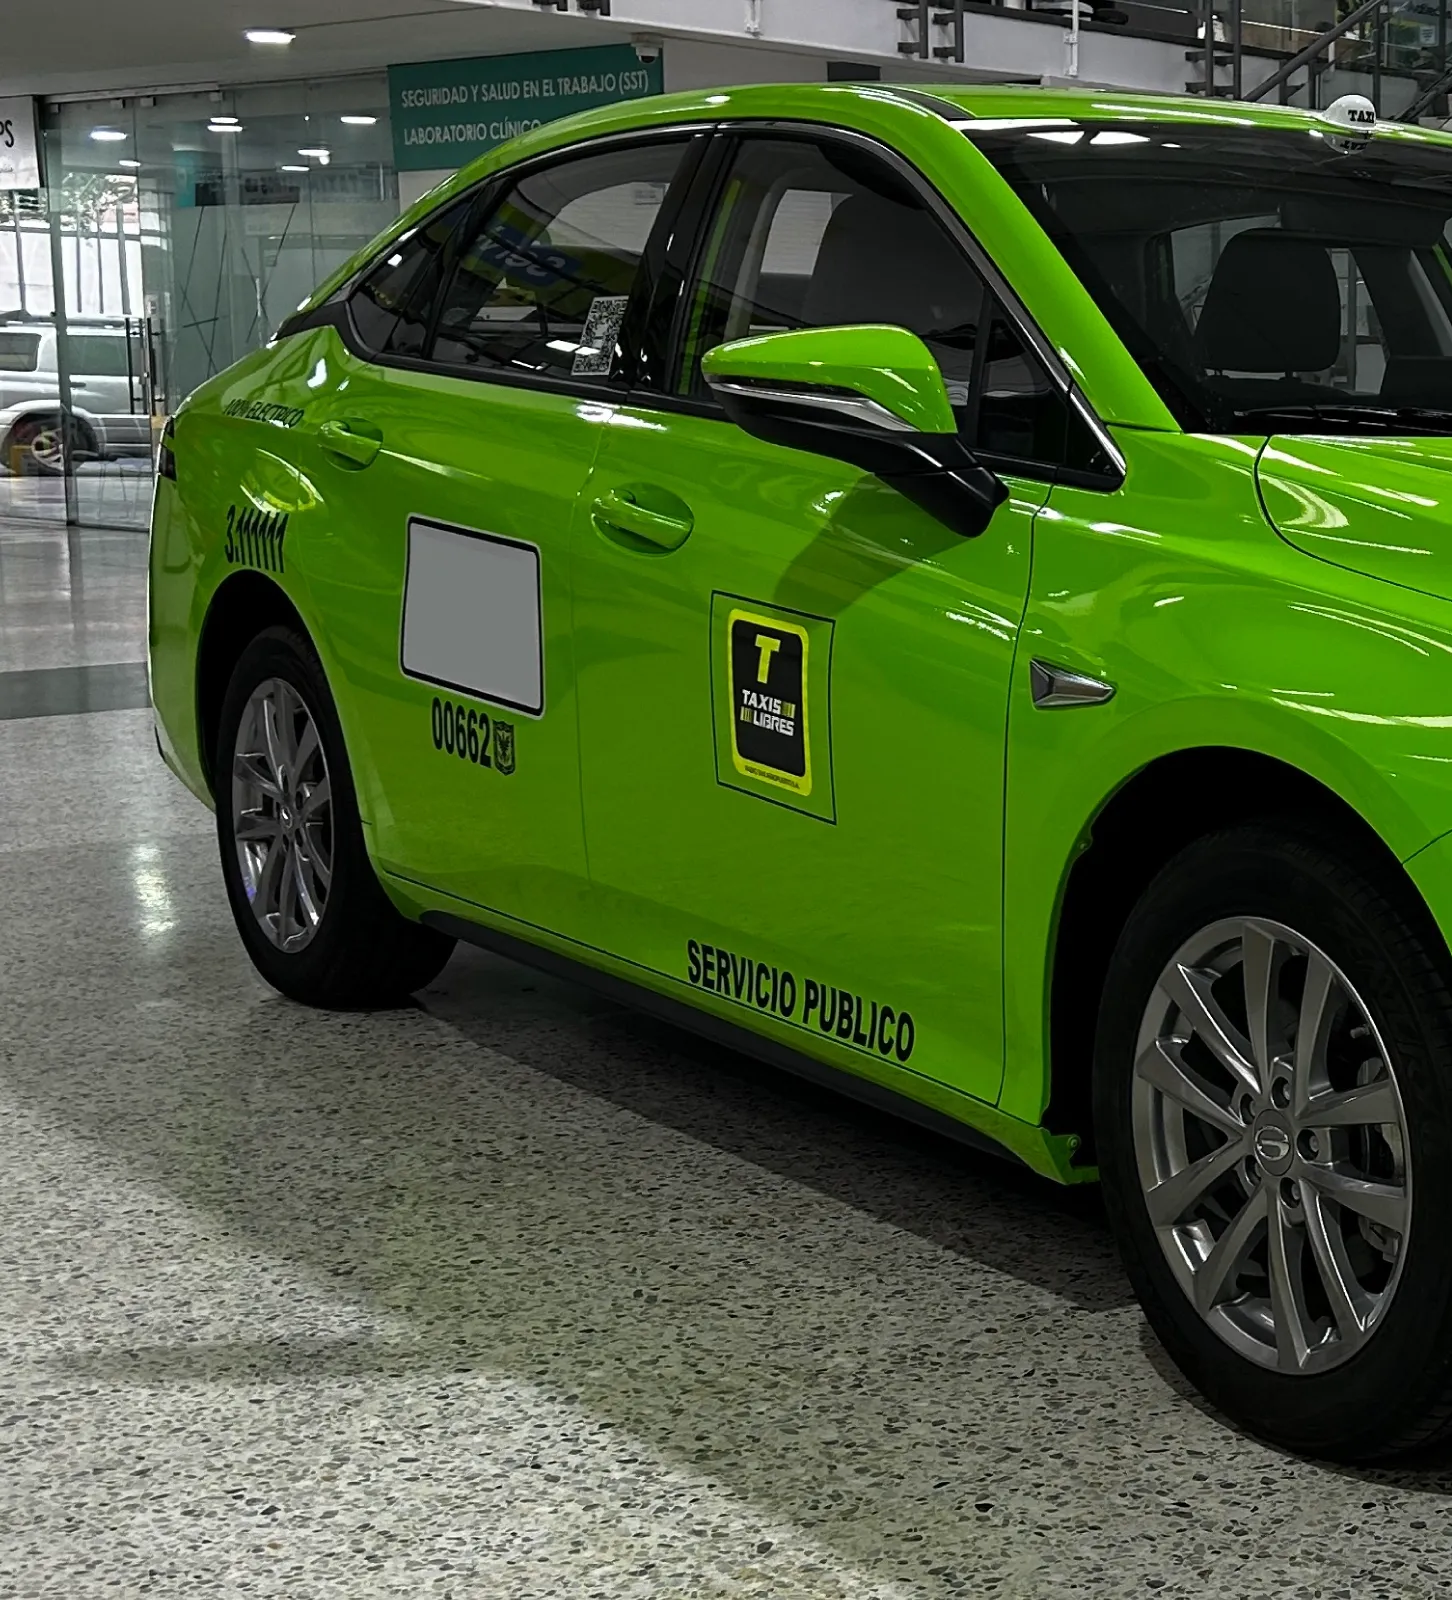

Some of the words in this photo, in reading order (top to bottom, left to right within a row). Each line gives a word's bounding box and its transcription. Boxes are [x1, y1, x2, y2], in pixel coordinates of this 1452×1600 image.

[401, 88, 468, 108] SEGURIDAD
[471, 85, 479, 102] Y
[481, 81, 520, 102] SALUD
[523, 79, 540, 98] EN
[542, 78, 555, 97] EL
[557, 73, 616, 96] TRABAJO
[619, 69, 649, 95] (SST)
[404, 123, 487, 146] LABORATORIO
[489, 116, 542, 140] CLÍNICO
[1348, 109, 1375, 124] TAXI
[755, 633, 782, 684] T
[741, 688, 782, 715] TAXIS
[431, 696, 492, 769] 00662
[752, 710, 796, 738] LIBRES
[687, 938, 797, 1018] SERVICIO
[802, 978, 915, 1062] PUBLICO
